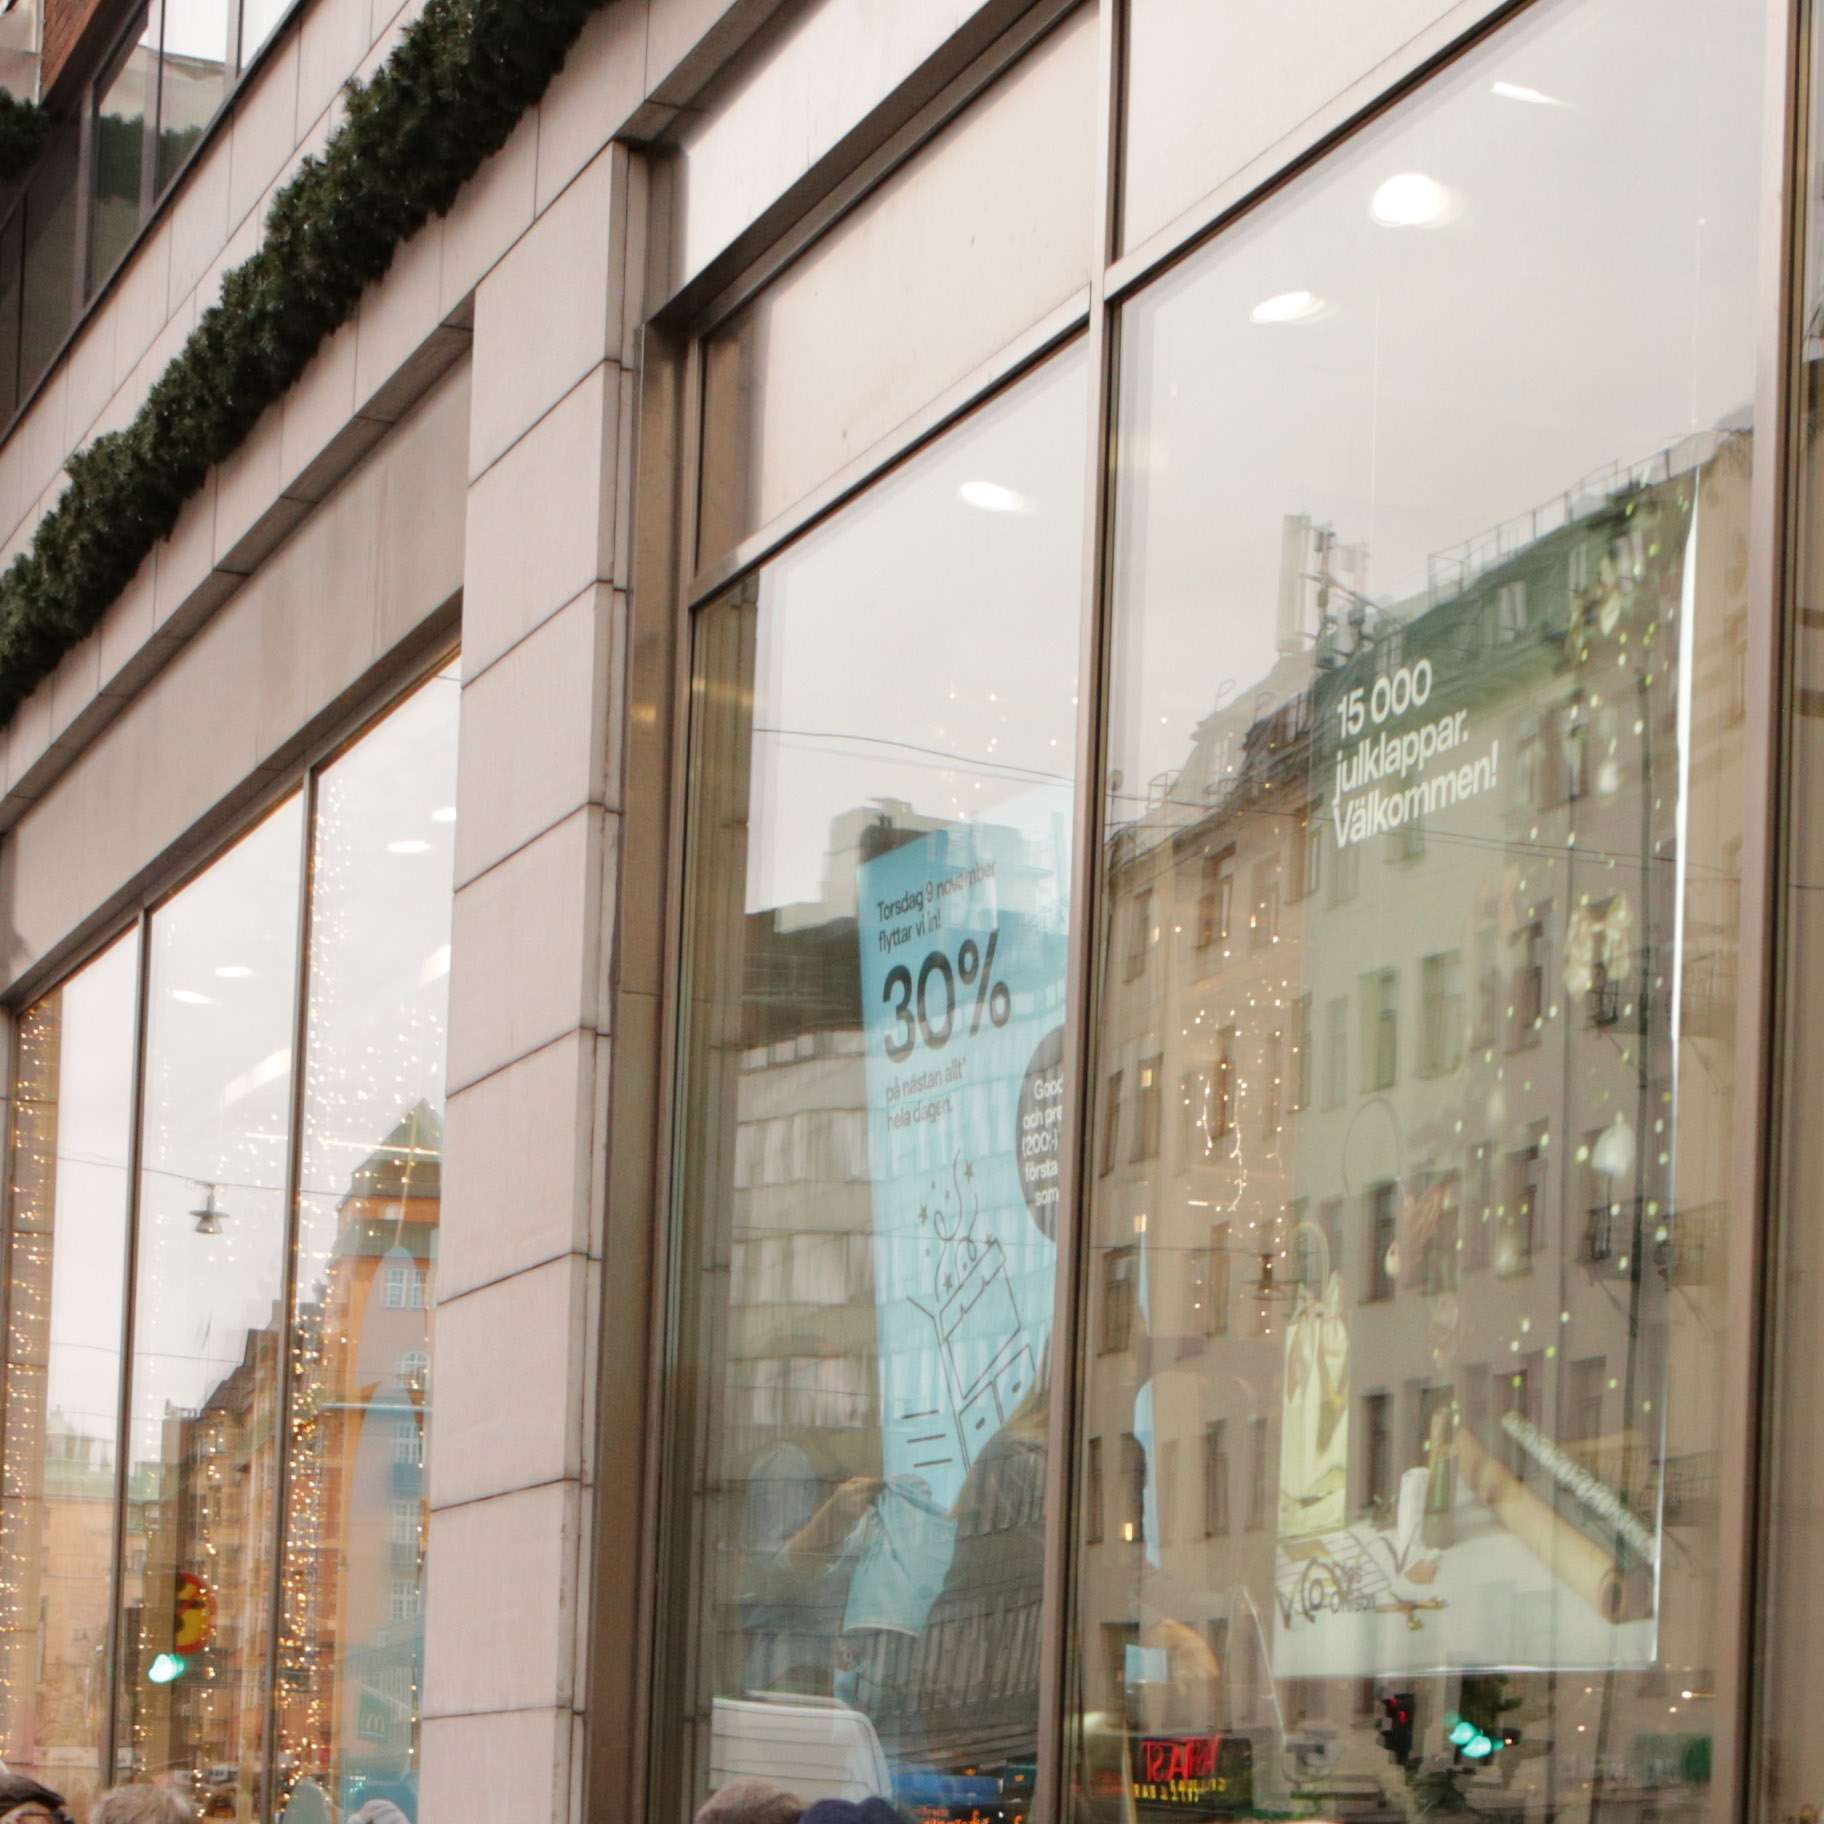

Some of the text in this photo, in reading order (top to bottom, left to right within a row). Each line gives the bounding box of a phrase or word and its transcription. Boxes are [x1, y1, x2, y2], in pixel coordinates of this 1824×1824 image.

[1337, 658, 1432, 740] 15 000
[1332, 708, 1469, 804] julklappar.
[1333, 740, 1499, 848] Välkommen!
[876, 860, 997, 923] Torsdag 9 november
[878, 908, 941, 954] flyttar vi in!
[882, 927, 1011, 1064] 30%
[885, 1076, 901, 1103] på
[903, 1068, 942, 1096] nästan
[887, 1097, 953, 1132] hela dagen.
[1022, 1106, 1044, 1130] och
[1025, 1159, 1058, 1183] första
[1034, 1186, 1060, 1206] som
